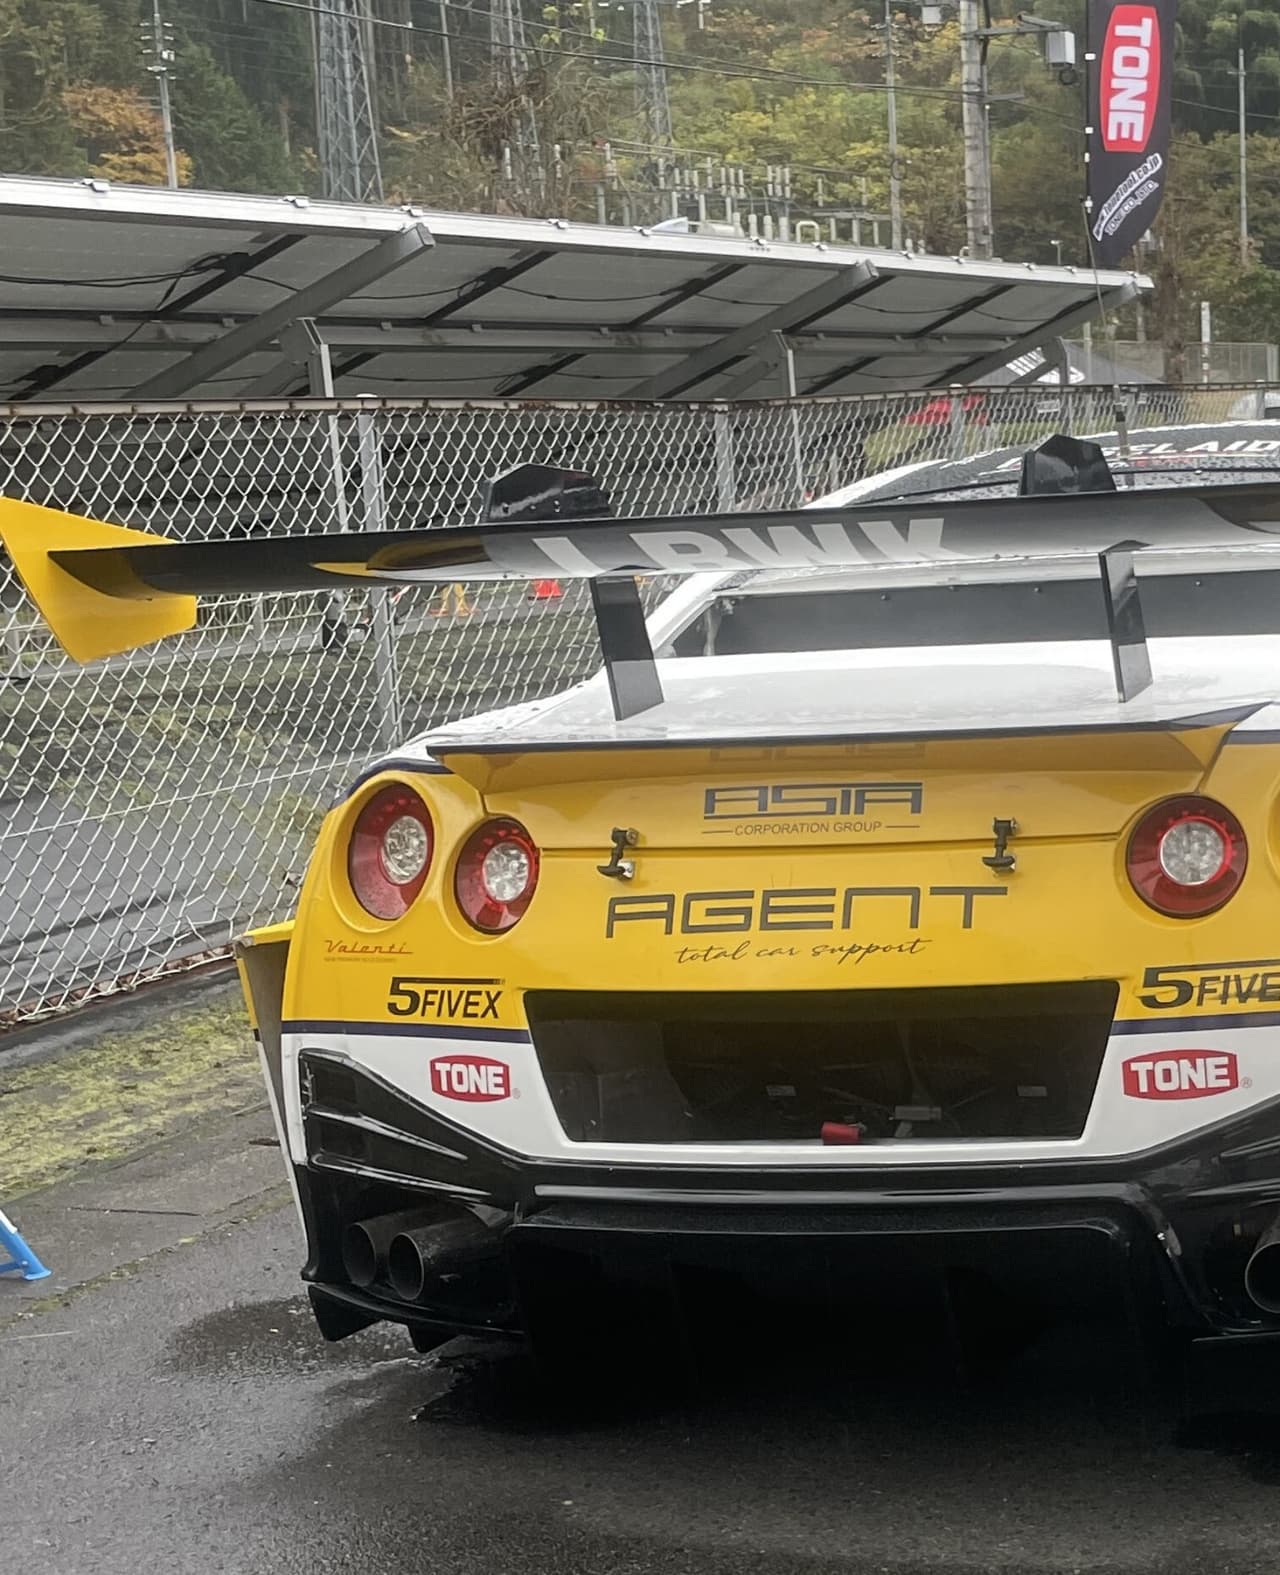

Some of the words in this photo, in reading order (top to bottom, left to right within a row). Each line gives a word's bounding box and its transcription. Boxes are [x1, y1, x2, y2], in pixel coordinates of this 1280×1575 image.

[1107, 17, 1152, 142] TONE
[531, 518, 970, 577] LBWK
[704, 782, 923, 820] ASIA
[734, 823, 831, 836] CORPORATION
[833, 821, 882, 833] GROUP
[606, 886, 1009, 938] AGENT
[324, 939, 413, 954] Valenti
[674, 941, 751, 964] total
[757, 944, 800, 957] car
[811, 937, 932, 965] support
[435, 1062, 505, 1095] TONE
[1130, 1056, 1230, 1093] TONE
